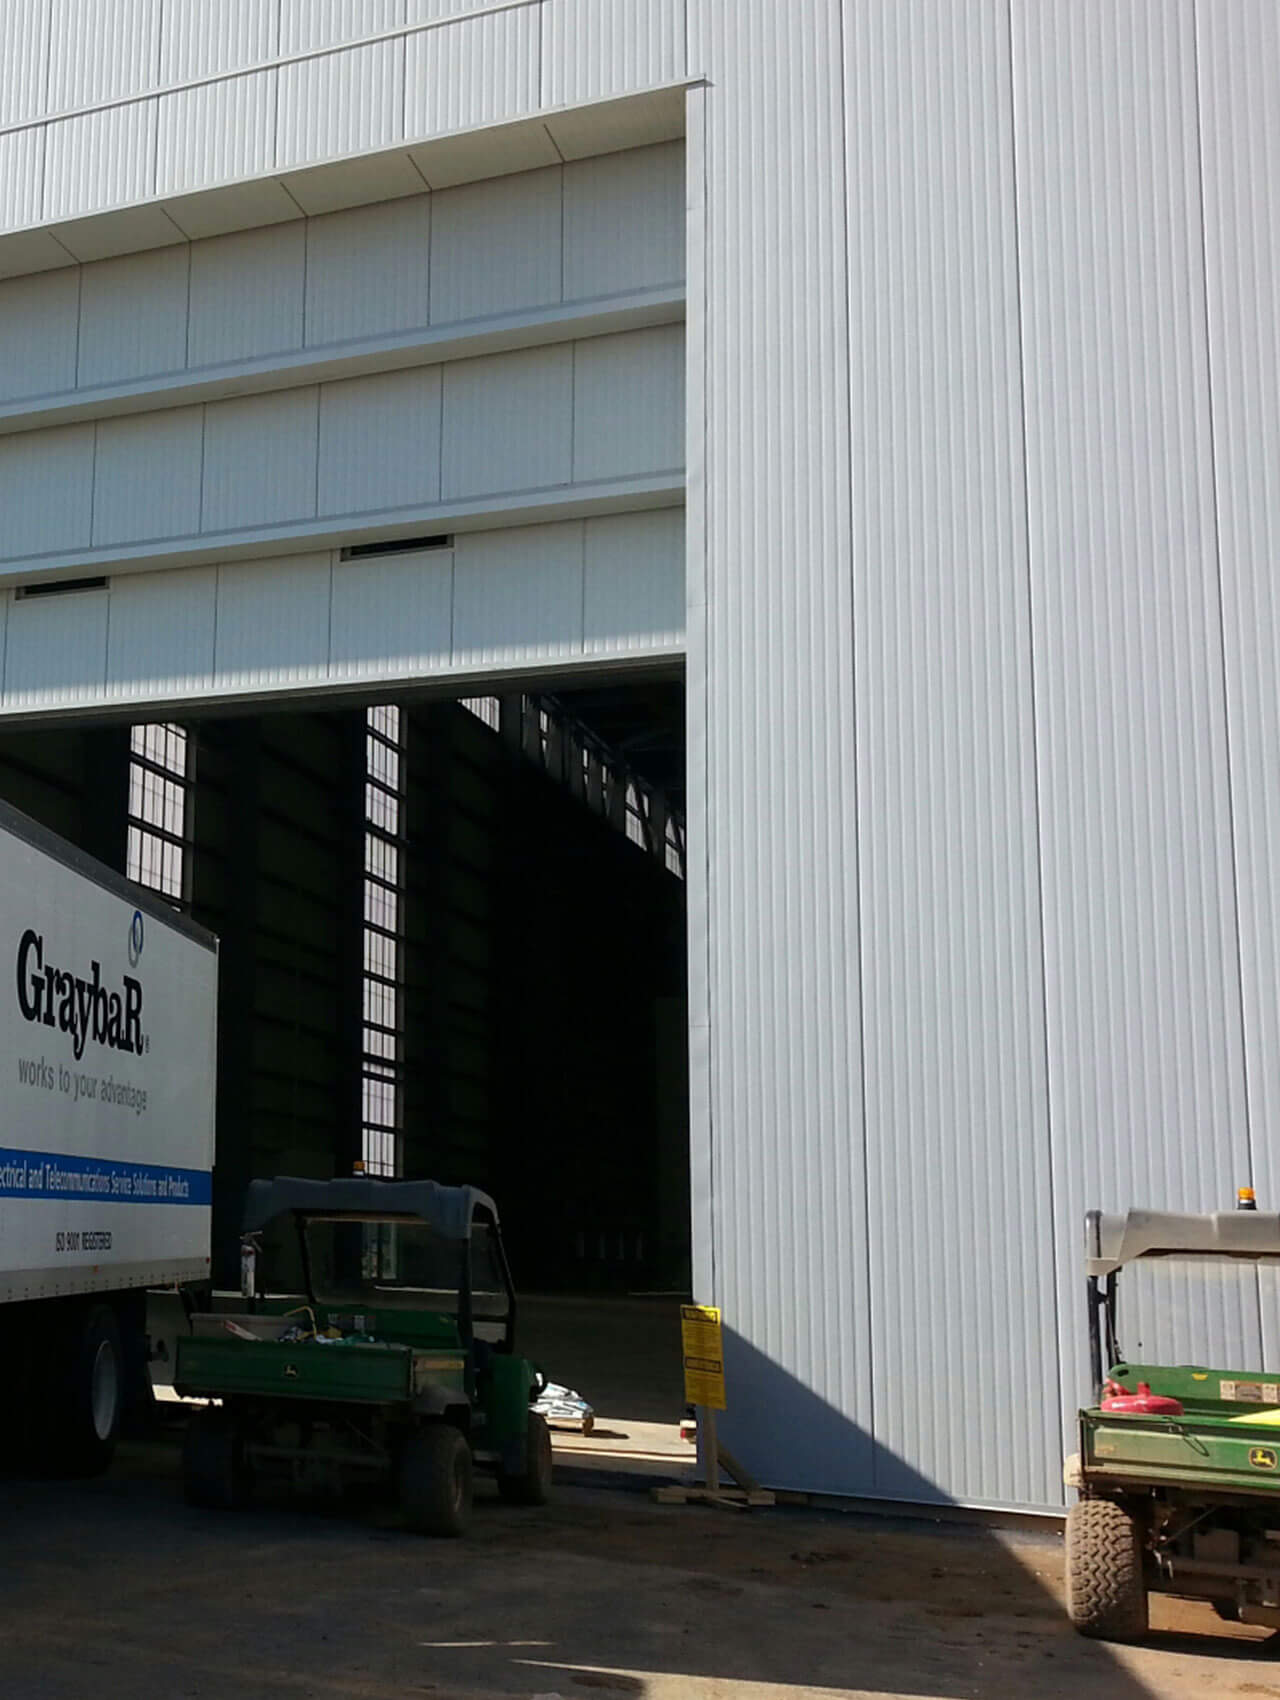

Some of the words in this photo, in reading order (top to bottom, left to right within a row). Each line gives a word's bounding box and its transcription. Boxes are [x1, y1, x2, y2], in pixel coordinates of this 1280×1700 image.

[19, 1055, 55, 1090] works
[59, 1064, 70, 1093] to
[73, 1073, 98, 1102] your
[101, 1075, 147, 1116] advantage
[28, 1162, 43, 1189] and
[45, 1163, 110, 1193] Telecommunications
[111, 1170, 132, 1195] Service
[132, 1172, 157, 1197] Solutions
[158, 1175, 168, 1197] and
[169, 1175, 190, 1198] Products
[56, 1232, 65, 1251] ISO
[66, 1232, 80, 1251] 9001
[81, 1232, 112, 1250] REGISTERED
